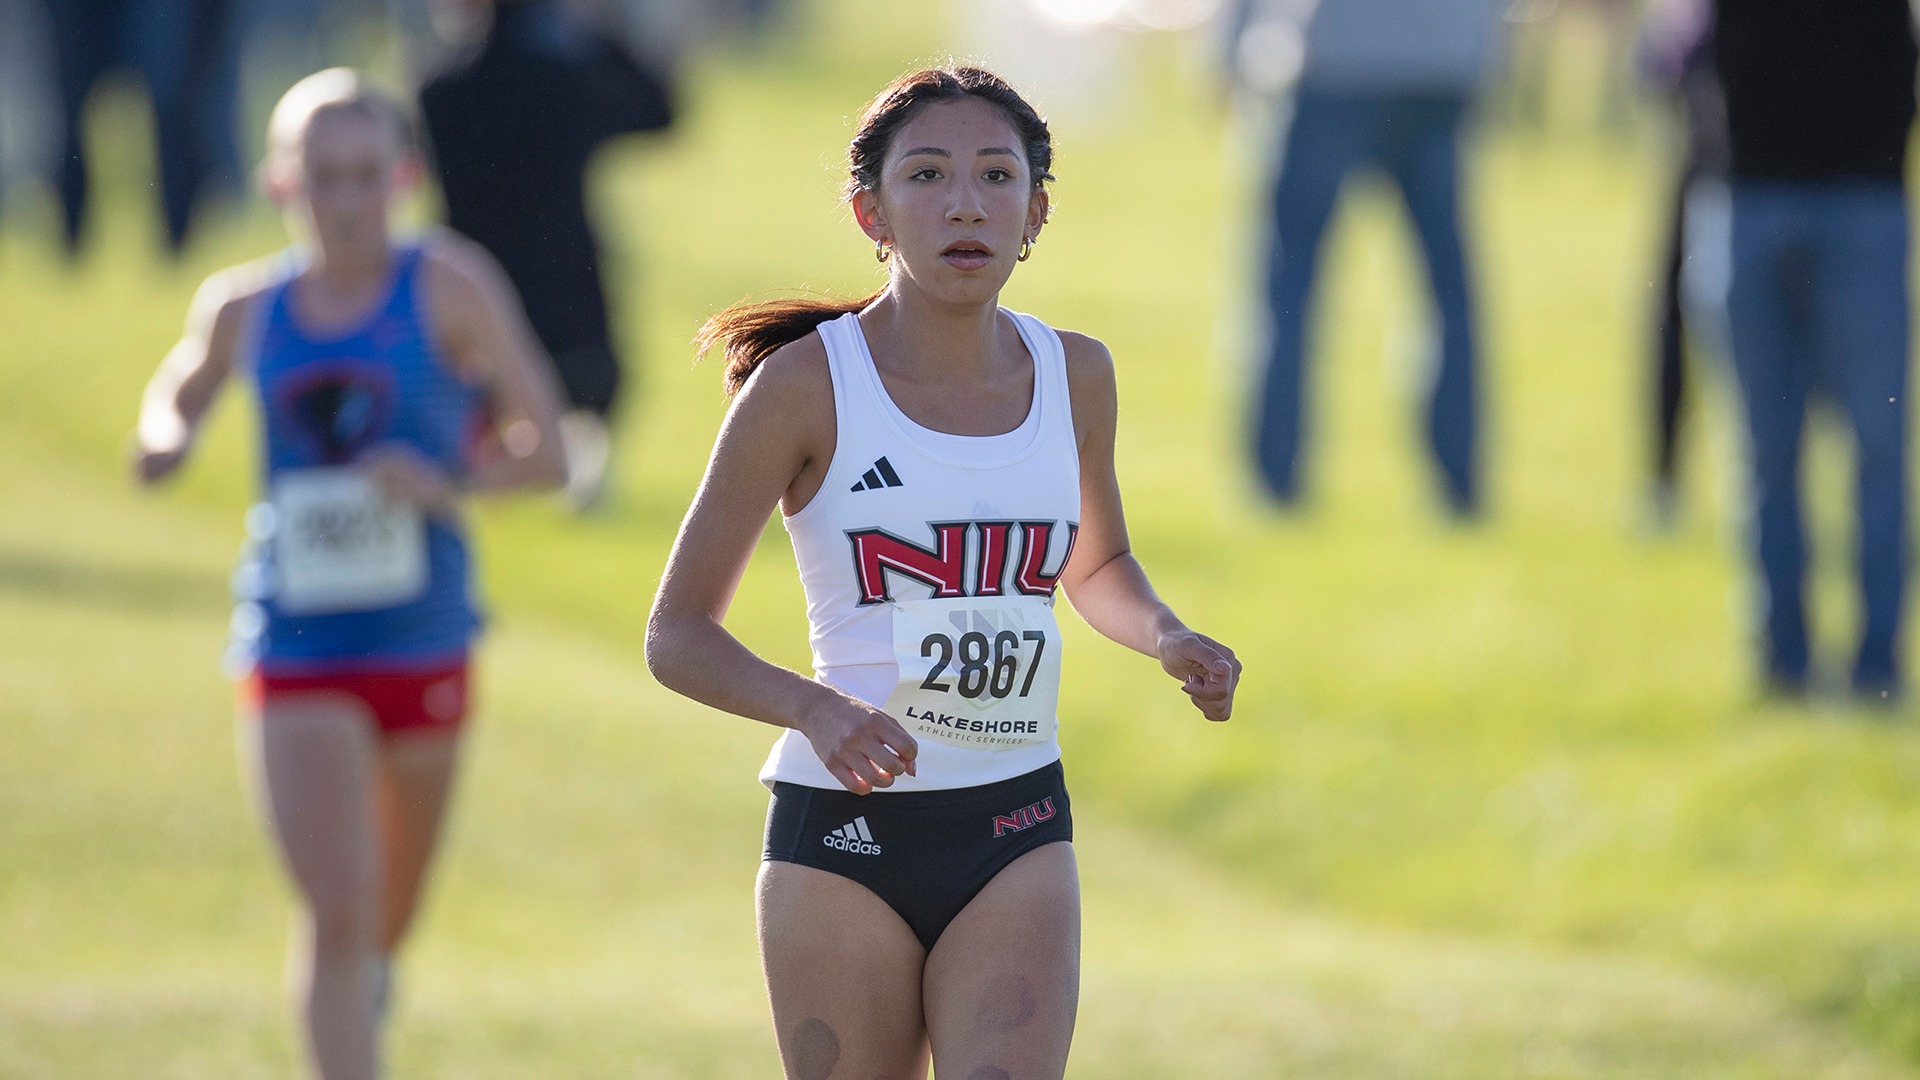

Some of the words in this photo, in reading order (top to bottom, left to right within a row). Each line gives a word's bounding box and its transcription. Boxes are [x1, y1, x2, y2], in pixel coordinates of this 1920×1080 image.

[842, 518, 1079, 608] NIU
[919, 630, 1046, 699] 2867
[906, 706, 1038, 734] LAKESHORE
[917, 724, 971, 742] ATHLETIC
[992, 796, 1057, 838] NIU
[823, 833, 882, 856] adidas
